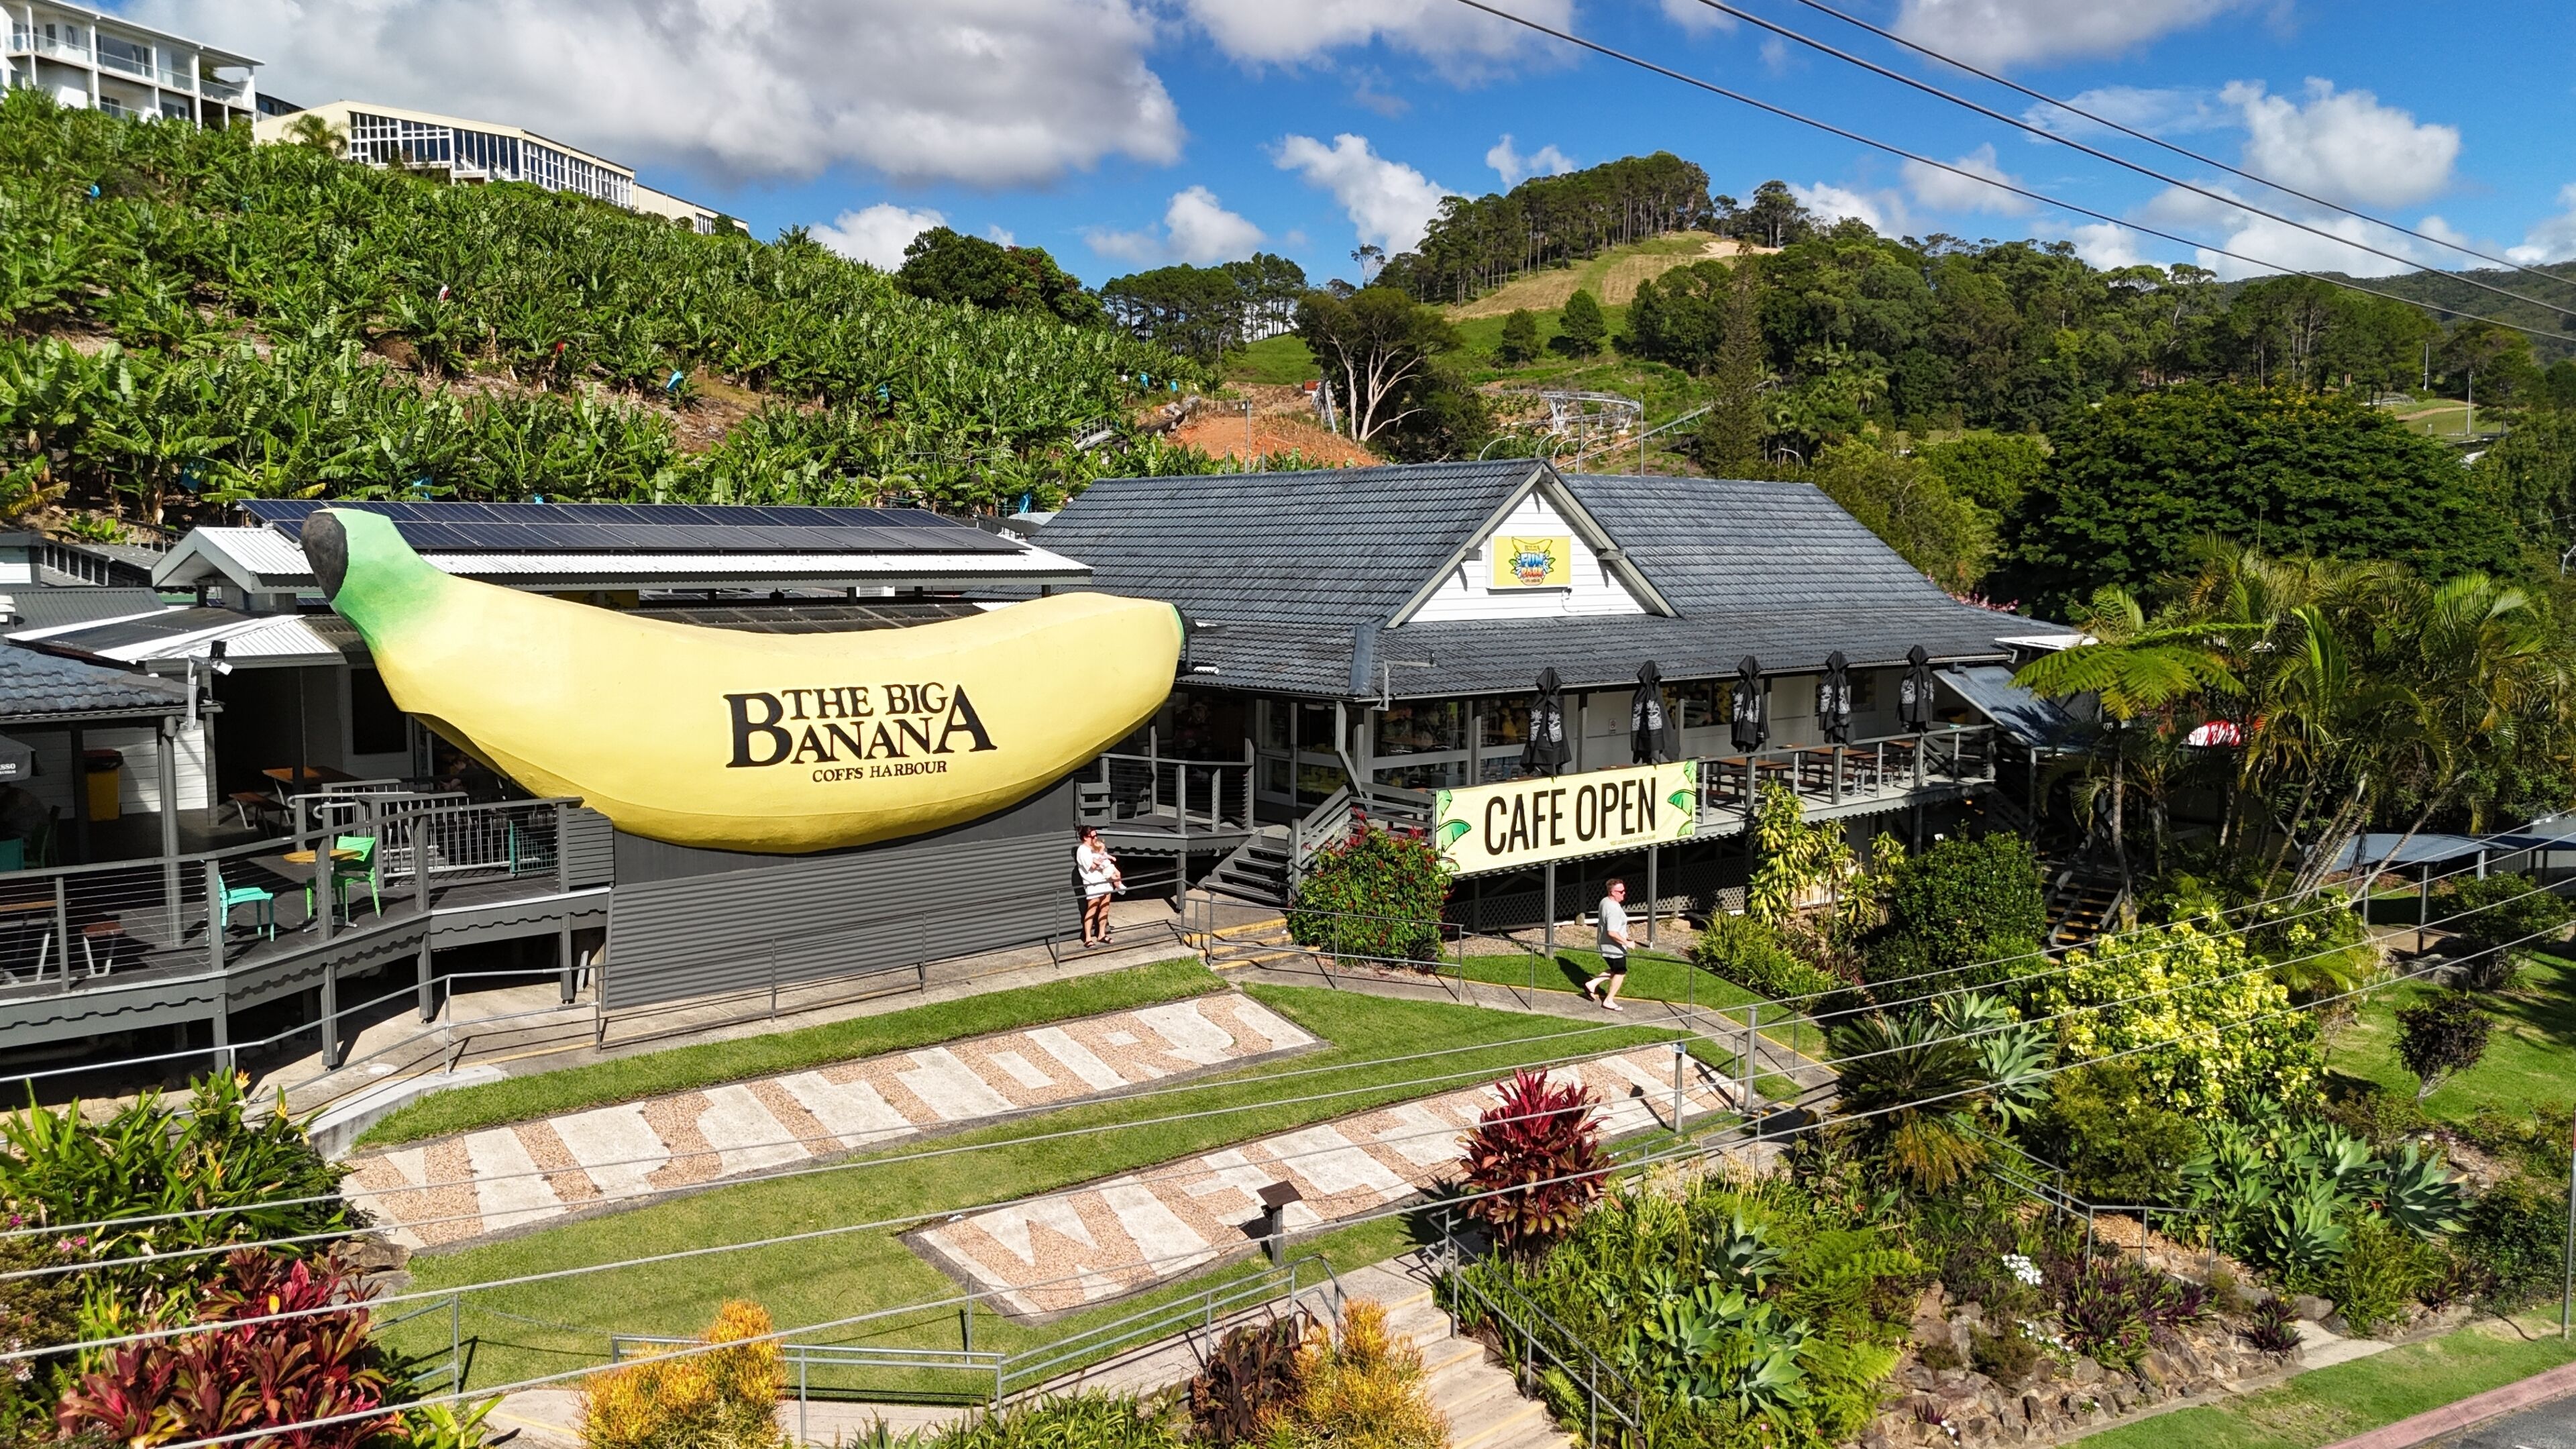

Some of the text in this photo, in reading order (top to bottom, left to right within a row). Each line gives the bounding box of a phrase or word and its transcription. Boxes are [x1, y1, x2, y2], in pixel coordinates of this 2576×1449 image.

[1520, 552, 1544, 568] FUN
[722, 684, 998, 768] BANANA
[782, 682, 949, 720] THE BIG
[812, 760, 947, 783] COFFS HARBOUR
[1485, 777, 1656, 855] CAFE OPEN
[342, 993, 1273, 1246] VISITORS
